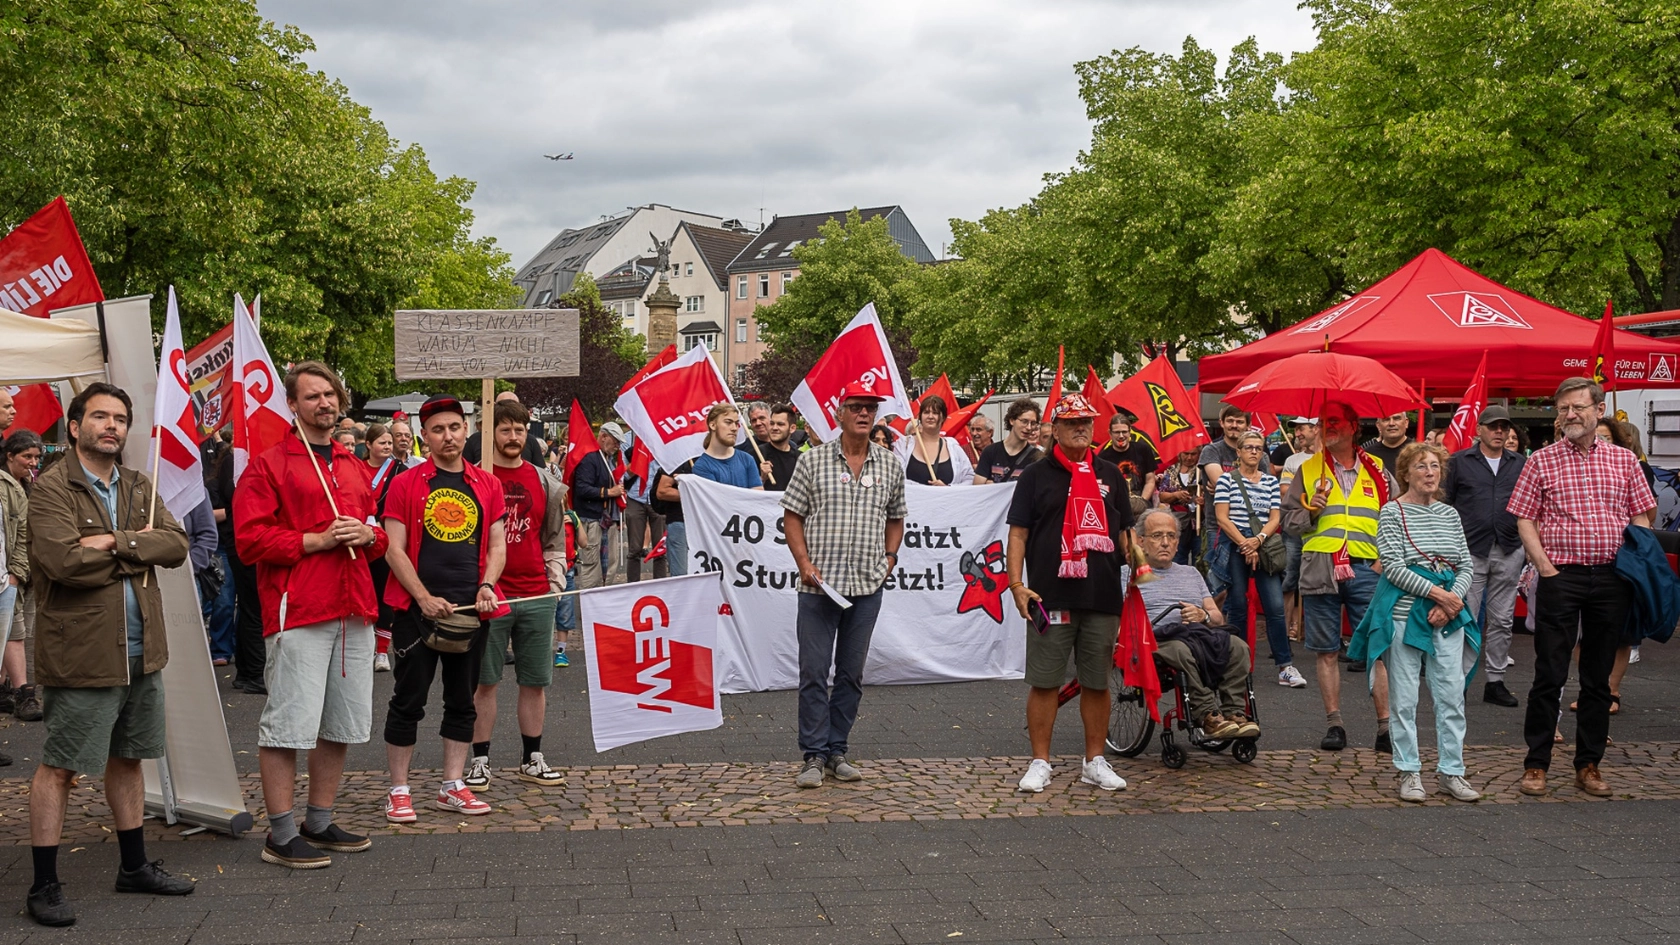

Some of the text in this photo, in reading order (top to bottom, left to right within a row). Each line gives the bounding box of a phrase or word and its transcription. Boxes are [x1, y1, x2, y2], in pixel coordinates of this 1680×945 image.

[417, 335, 551, 353] WARUM NICHT
[415, 355, 562, 372] MAL VON UNTEN?
[1620, 370, 1644, 379] LEBEN
[1631, 361, 1645, 370] EIN
[425, 490, 477, 515] LOHNARBEIT?
[425, 518, 475, 540] NEIN DANKE
[721, 514, 765, 544] 40
[883, 563, 945, 591] etzt!
[631, 595, 673, 714] GEW
